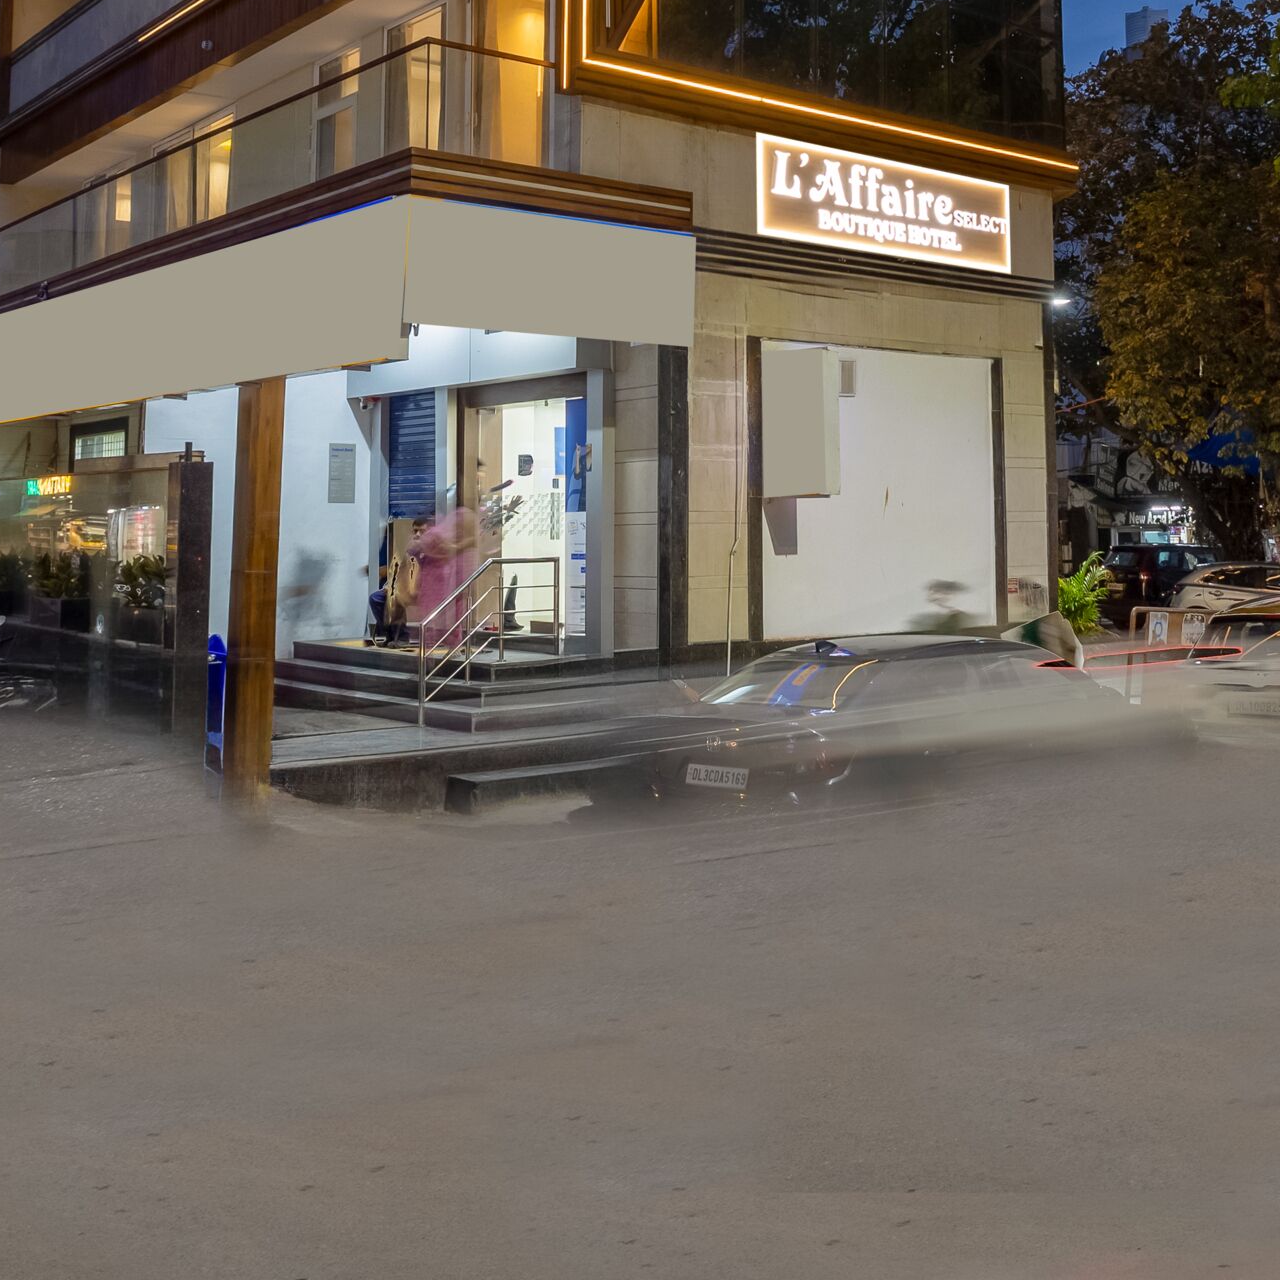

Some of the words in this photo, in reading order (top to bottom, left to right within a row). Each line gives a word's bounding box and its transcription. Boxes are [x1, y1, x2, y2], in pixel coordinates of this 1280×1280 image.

[771, 150, 953, 225] L'Affaire
[953, 209, 1007, 235] SELECT
[818, 208, 907, 243] BOUTIQUE
[907, 225, 962, 251] HOTEL
[692, 767, 747, 786] DL3CDA5169
